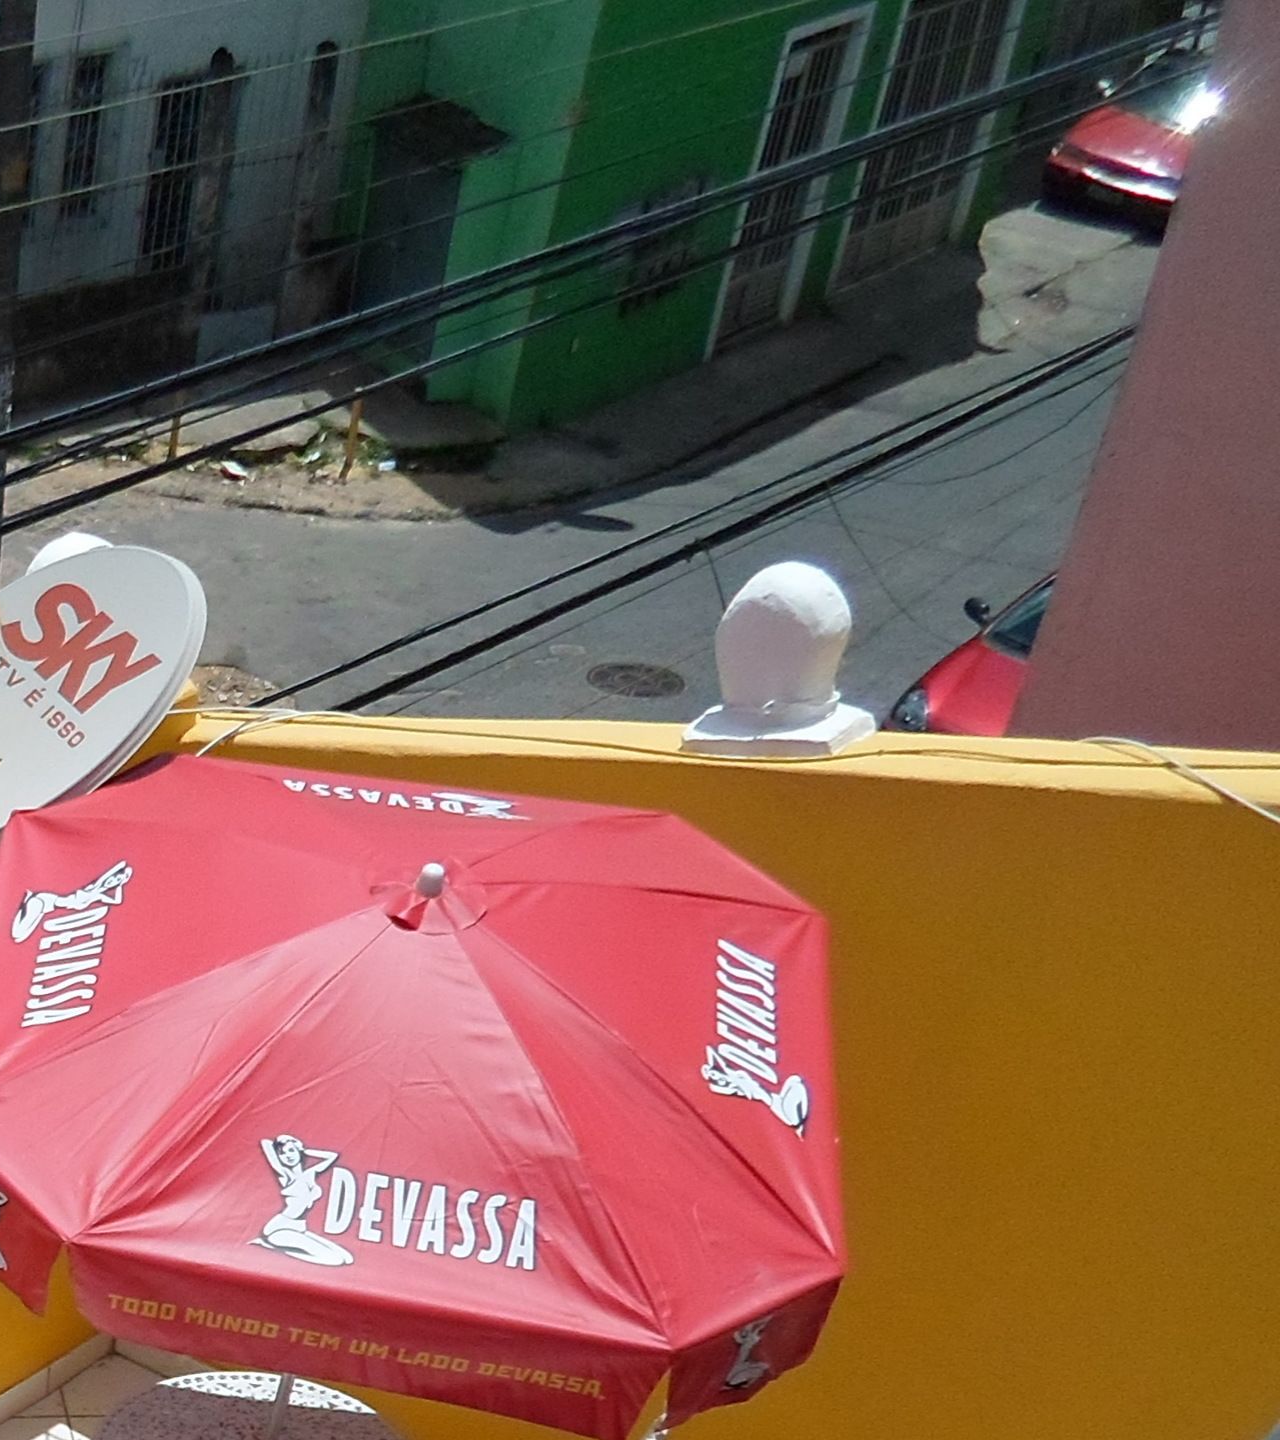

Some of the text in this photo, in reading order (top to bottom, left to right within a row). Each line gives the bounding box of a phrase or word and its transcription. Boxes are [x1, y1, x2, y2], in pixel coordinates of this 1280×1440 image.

[0, 582, 163, 715] SKY
[23, 687, 47, 709] É
[39, 705, 86, 749] ISSO
[282, 779, 465, 815] DEVASSA
[20, 905, 110, 1028] DEVASSA
[716, 938, 779, 1085] DEVASSA
[323, 1166, 537, 1271] DEVASSA
[108, 1293, 177, 1321] TODO
[184, 1306, 280, 1338] MUNDO
[287, 1327, 342, 1351] TEM
[348, 1338, 390, 1360] UM
[396, 1347, 471, 1373] LADO
